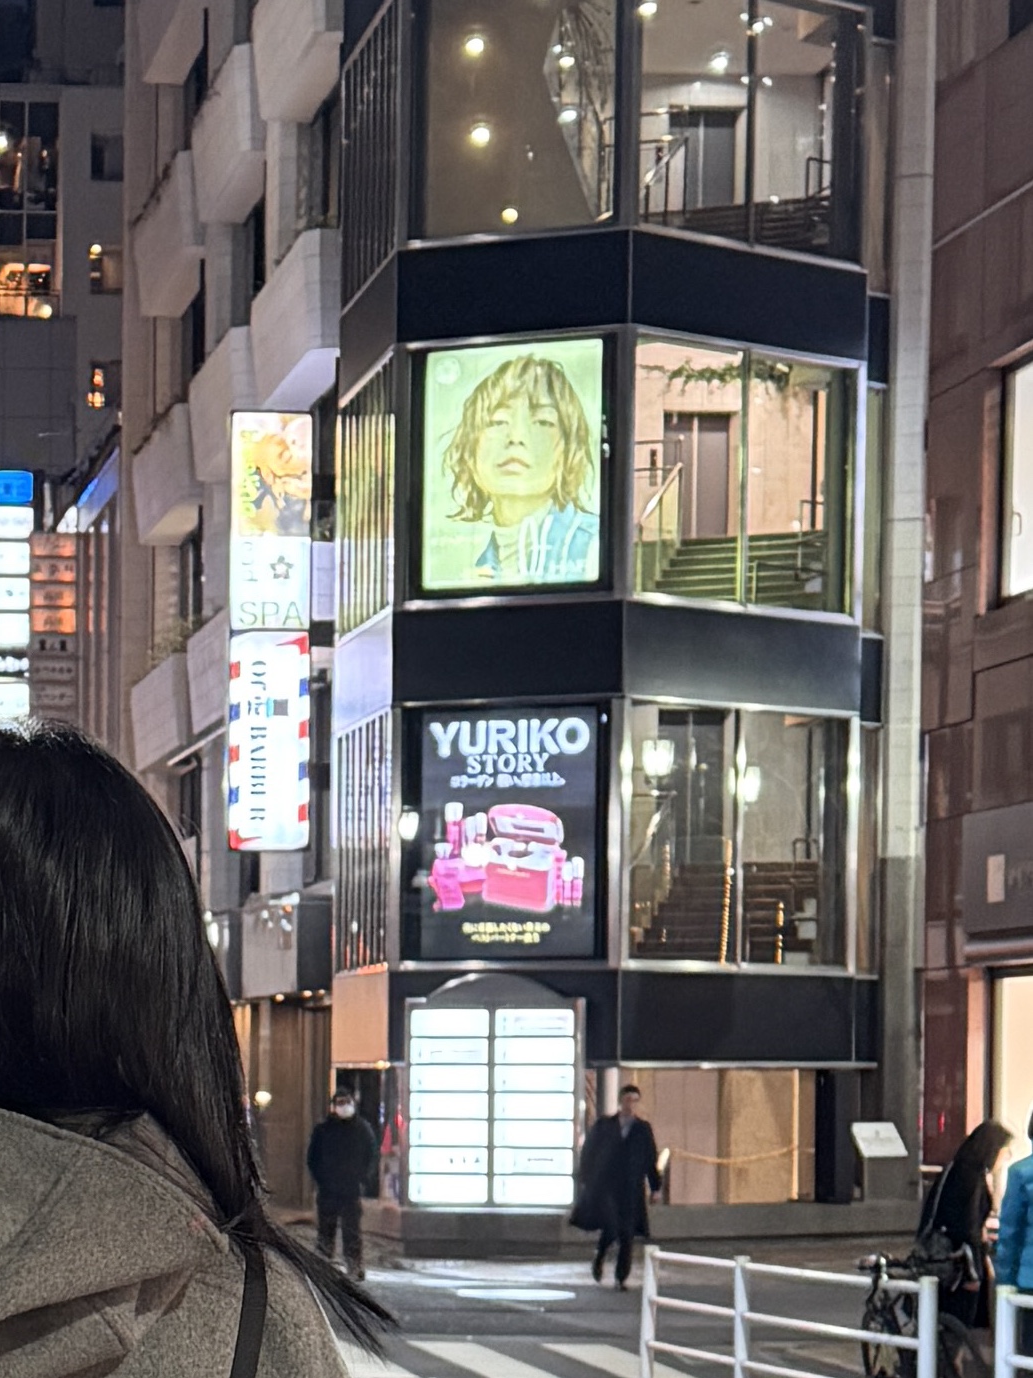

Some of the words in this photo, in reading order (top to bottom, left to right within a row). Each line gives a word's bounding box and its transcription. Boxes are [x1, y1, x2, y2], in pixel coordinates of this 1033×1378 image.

[239, 601, 304, 626] SPA
[430, 717, 591, 758] YURIKO
[466, 752, 550, 774] STORY
